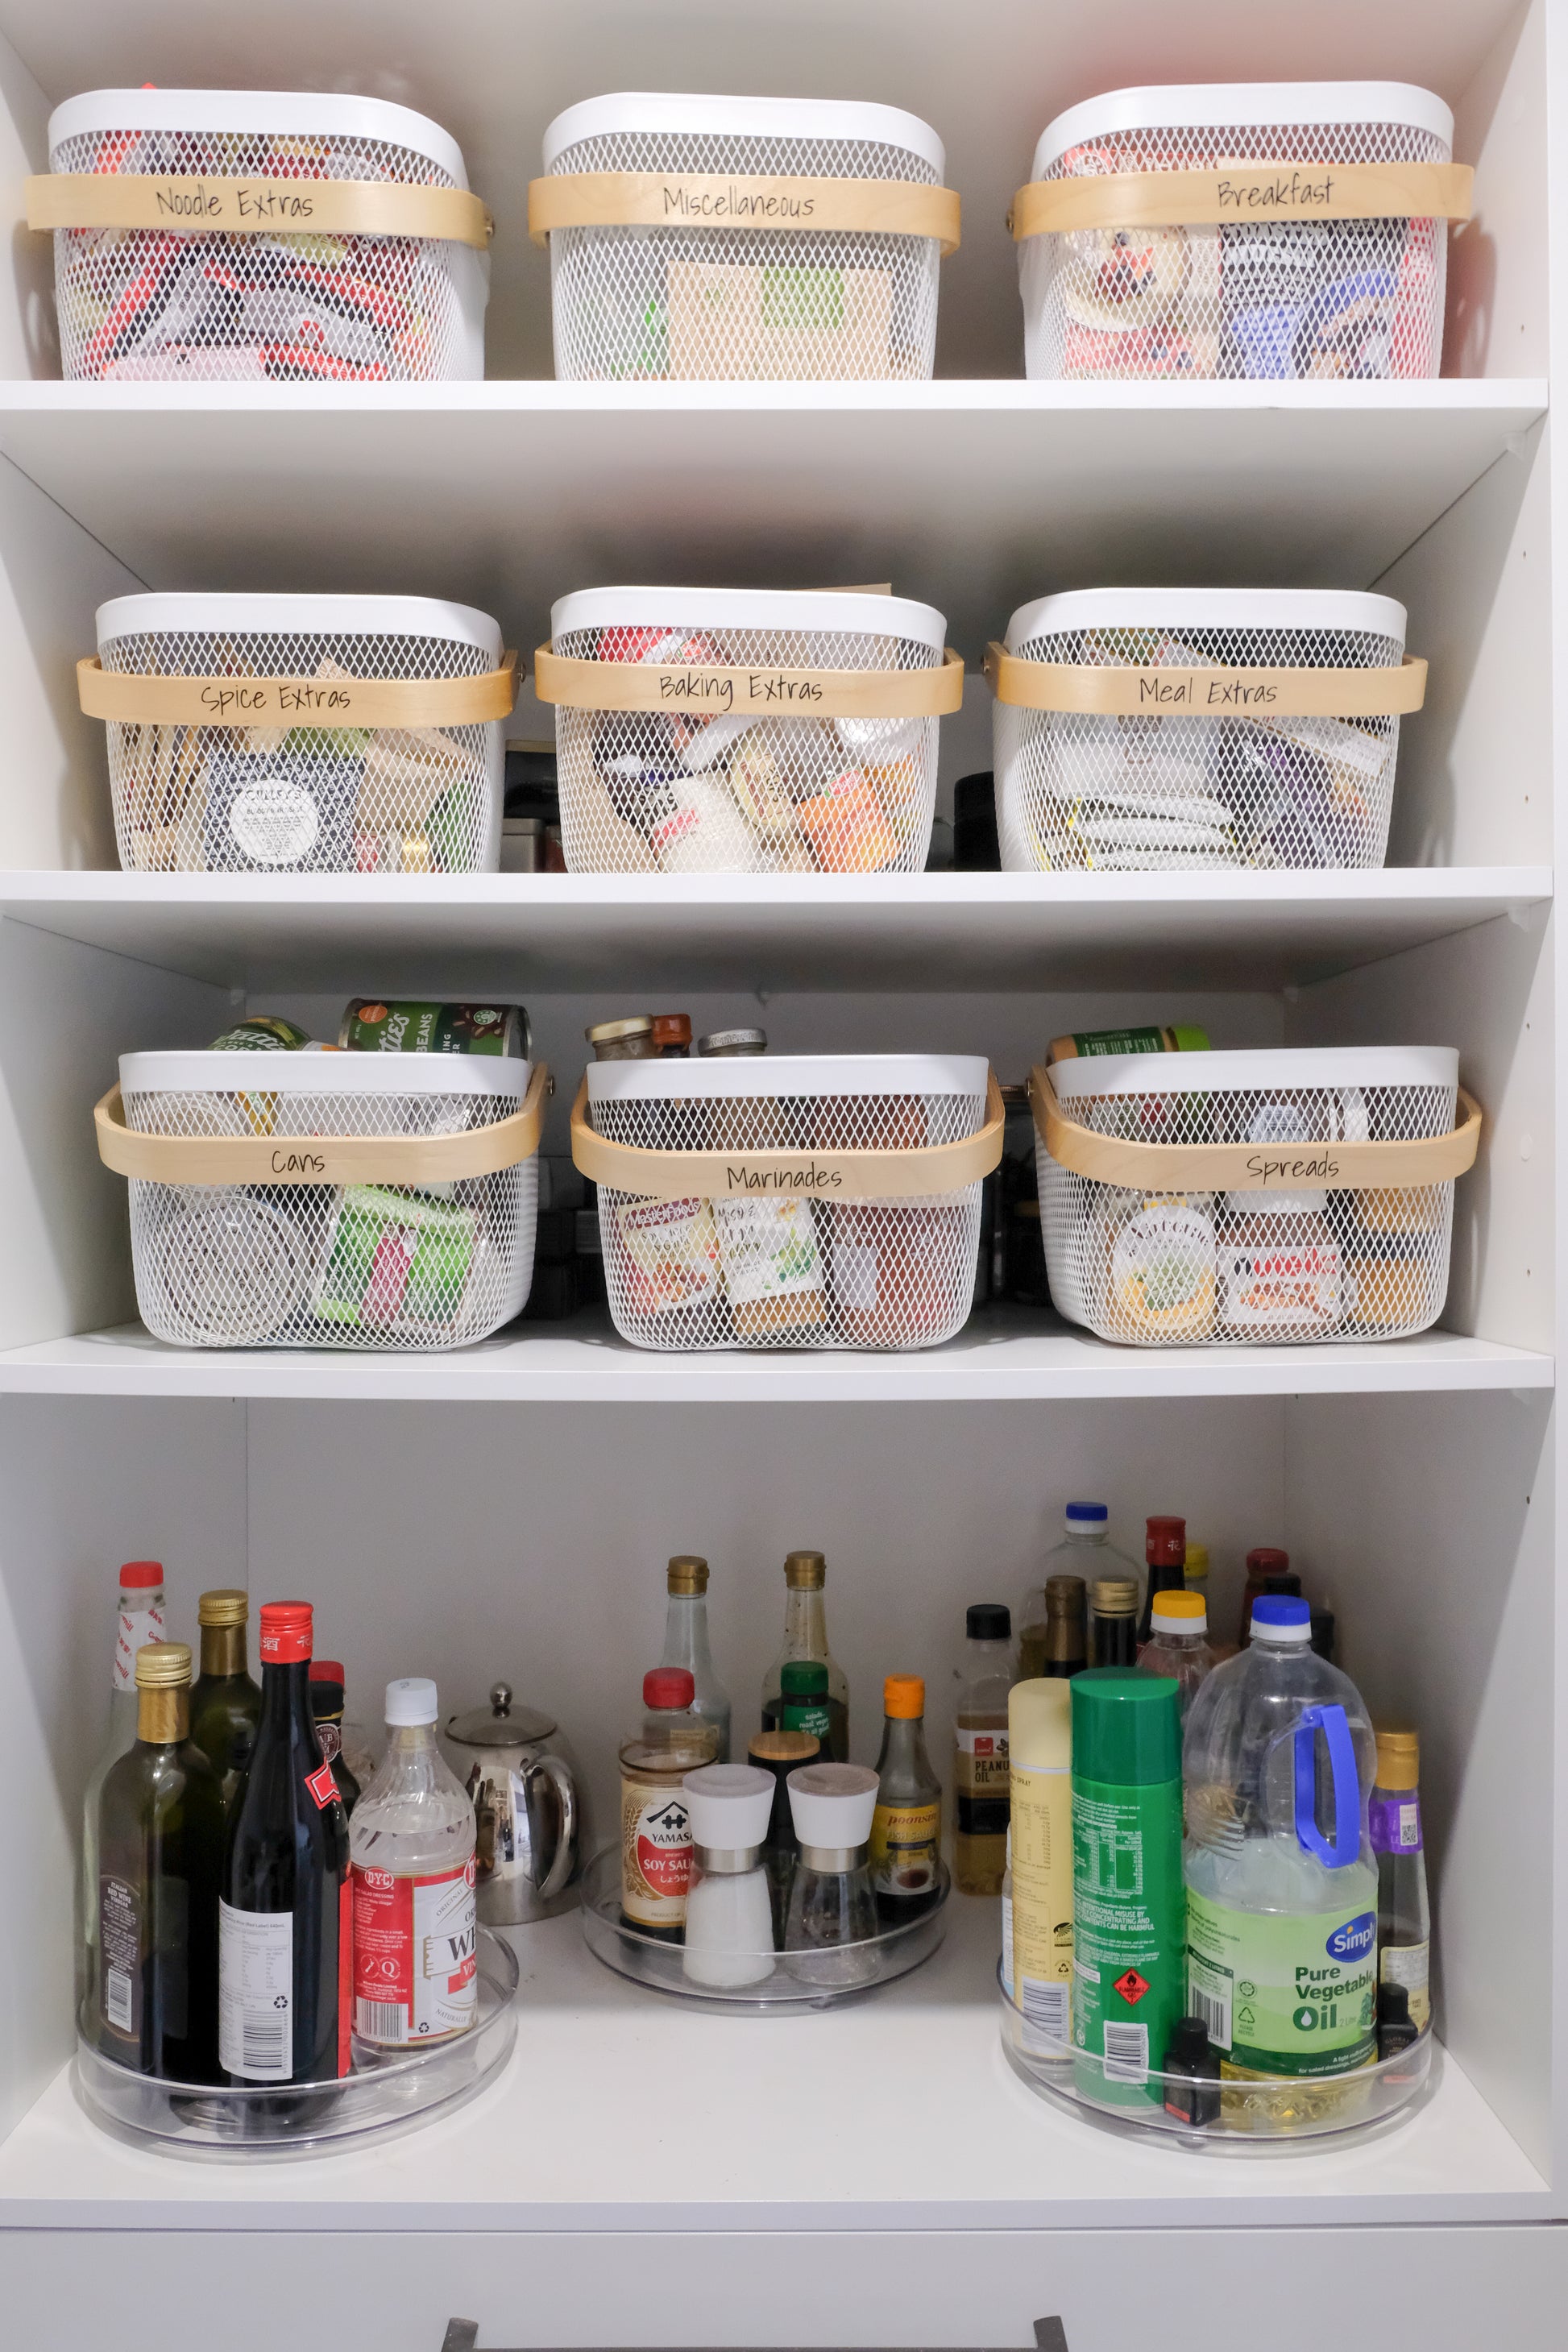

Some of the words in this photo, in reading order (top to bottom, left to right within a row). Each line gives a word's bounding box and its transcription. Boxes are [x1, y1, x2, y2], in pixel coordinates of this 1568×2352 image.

[156, 183, 222, 218] Noodle
[237, 189, 313, 219] Extras
[663, 186, 815, 218] Miscellaneous
[1217, 172, 1335, 208] Breakfast
[201, 685, 267, 716] Spice
[279, 683, 351, 710] Extras
[660, 673, 734, 711] Baking
[749, 674, 823, 701] Extras
[1139, 677, 1193, 704] Meal
[1207, 679, 1278, 704] Extras
[272, 1151, 326, 1174] Cans
[727, 1162, 843, 1190] Marinades
[1246, 1151, 1340, 1180] Spreads
[1234, 1247, 1338, 1277] nutella
[975, 1761, 1010, 1772] PEANU
[975, 1772, 990, 1782] OIL
[1016, 1777, 1031, 1786] SPRAY
[644, 1858, 666, 1870] SOY
[669, 1857, 691, 1871] SAU
[436, 1887, 464, 1917] ORIGINAL
[1115, 1910, 1136, 1918] MISUSE
[1106, 1922, 1119, 1931] CAN
[1119, 1923, 1127, 1931] BE
[1128, 1923, 1155, 1931] HARMFUL
[381, 1960, 396, 1978] Q
[1295, 1966, 1341, 1981] Pure
[1295, 1968, 1374, 2002] Vegetable
[436, 2008, 467, 2023] NATURALLY
[1292, 2003, 1338, 2031] Oil
